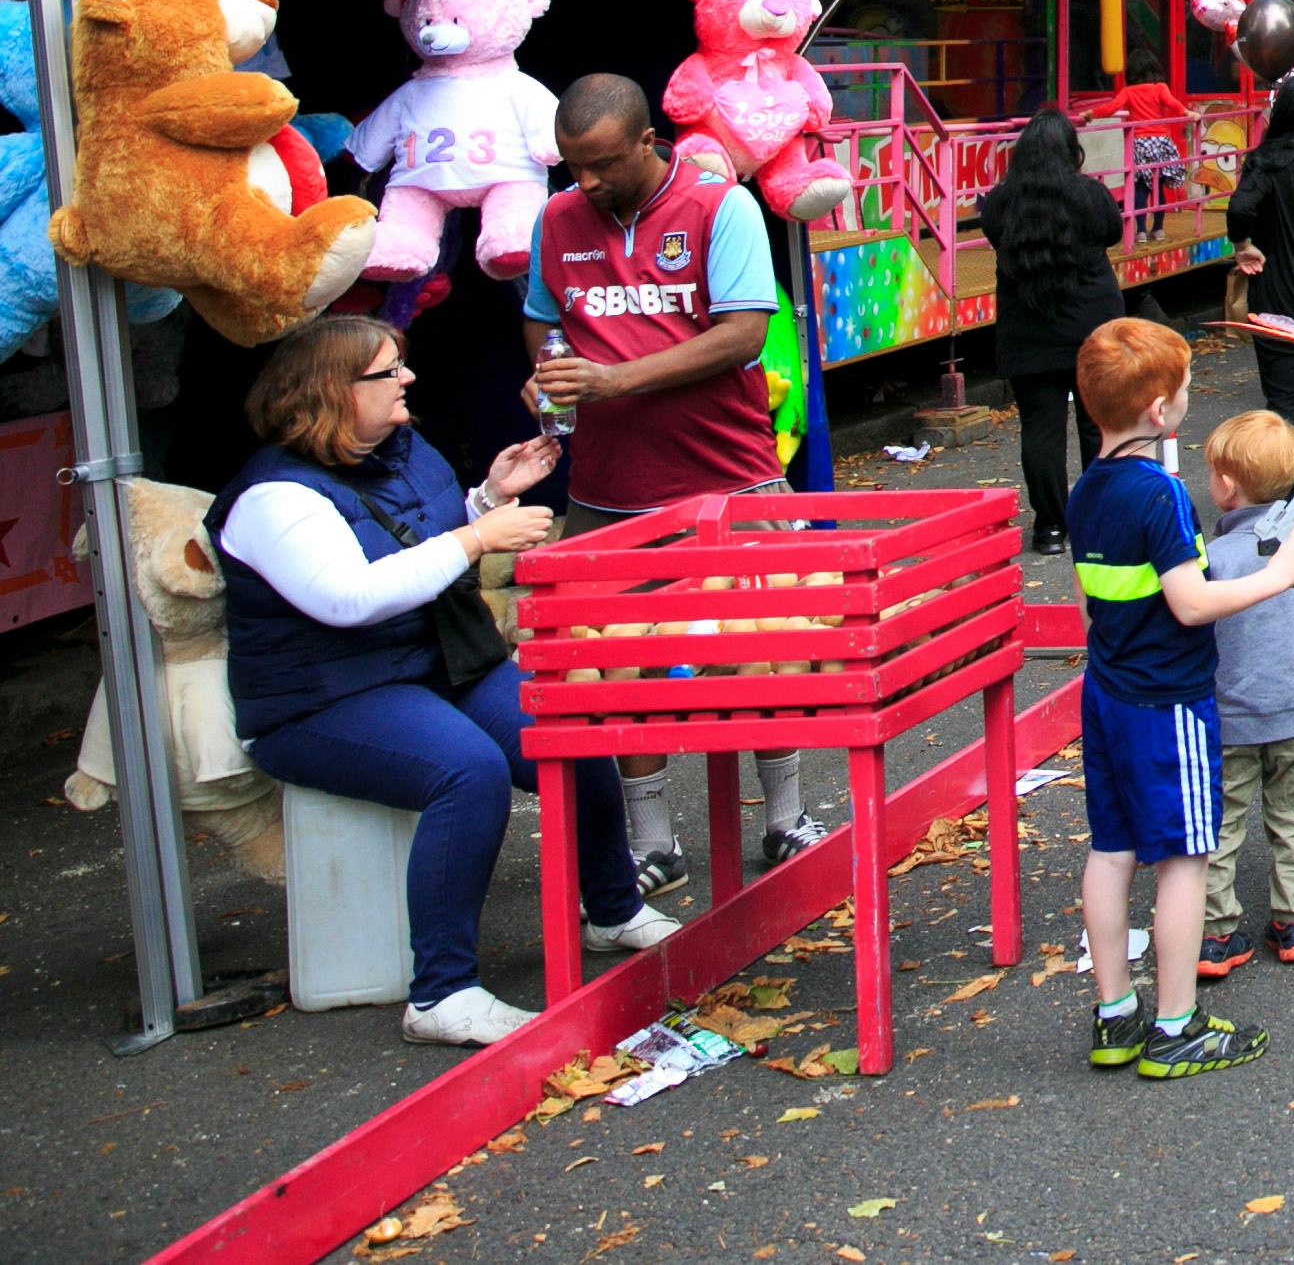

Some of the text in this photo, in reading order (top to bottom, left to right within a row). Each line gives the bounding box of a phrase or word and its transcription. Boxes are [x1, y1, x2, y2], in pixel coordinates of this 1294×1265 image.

[426, 127, 456, 165] 2
[467, 127, 497, 165] 3
[745, 127, 785, 142] you
[563, 249, 606, 262] macron
[584, 283, 697, 318] SBOBET
